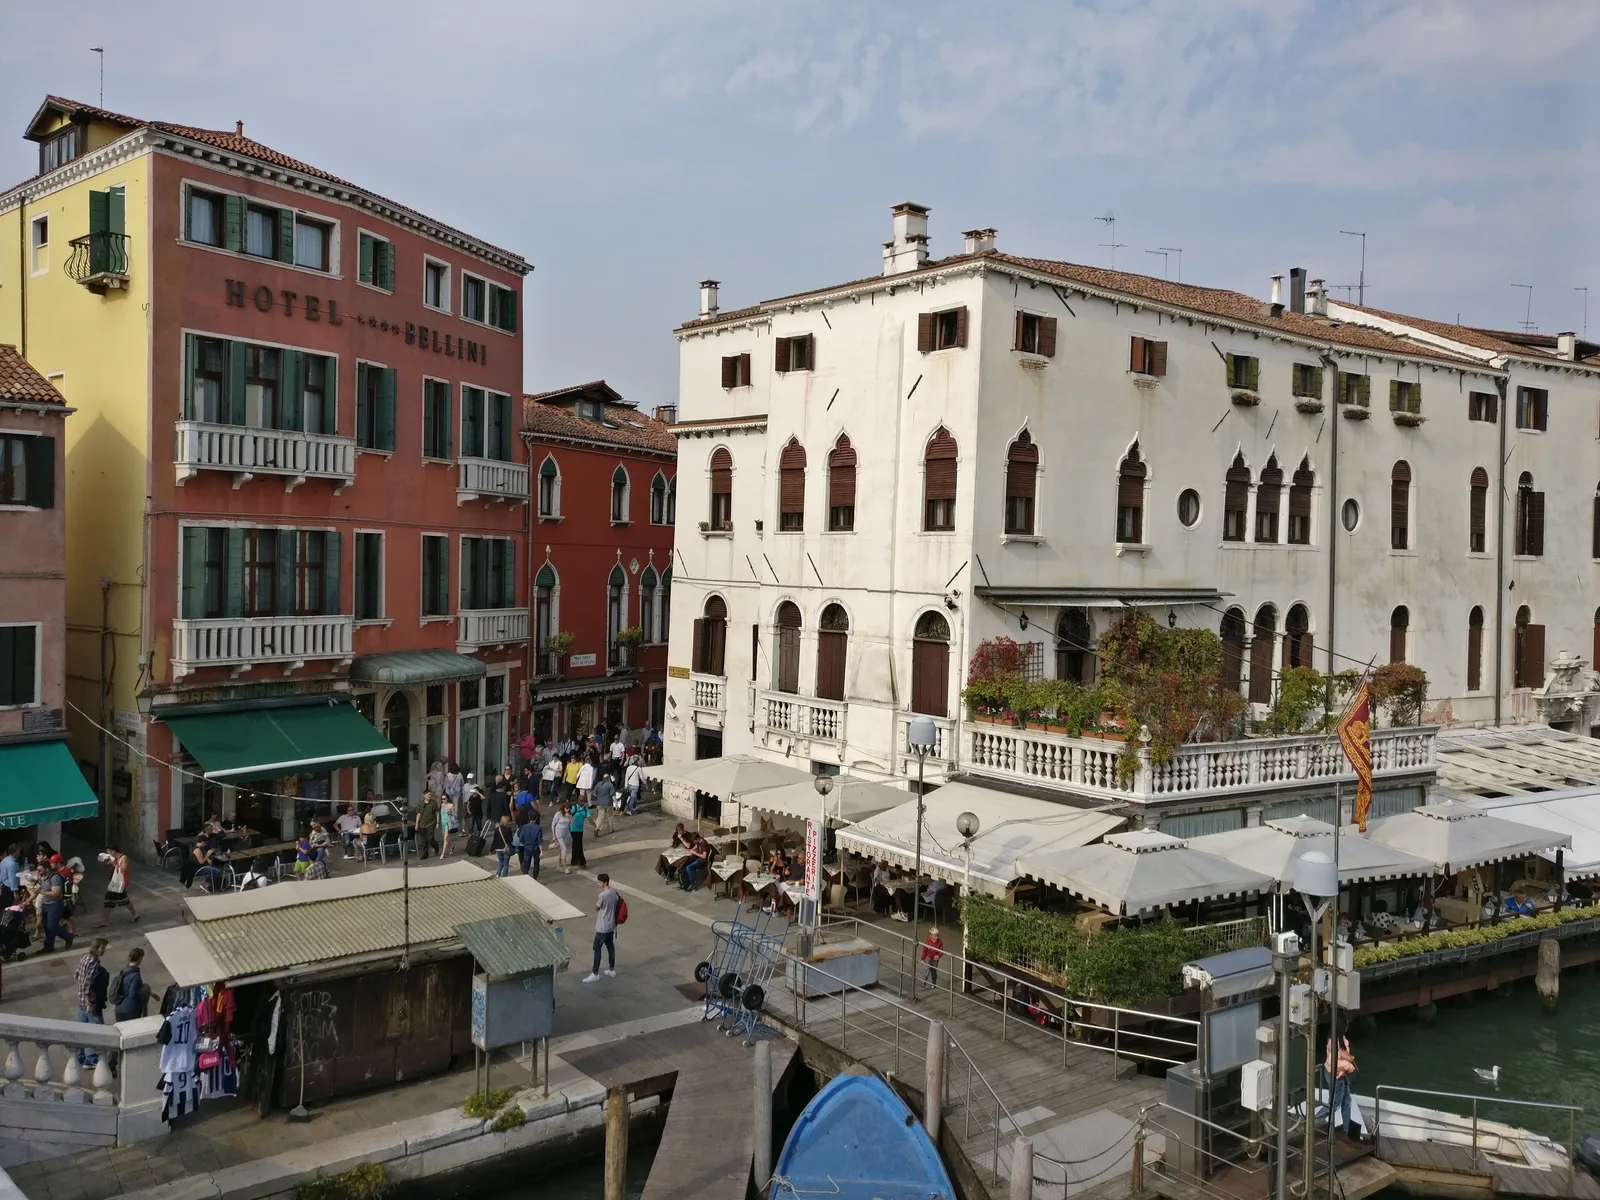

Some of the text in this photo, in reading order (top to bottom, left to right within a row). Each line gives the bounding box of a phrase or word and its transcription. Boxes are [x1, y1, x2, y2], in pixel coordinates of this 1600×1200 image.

[224, 278, 487, 366] HOTEL BELLINI
[428, 716, 443, 724] HOTEL
[840, 837, 954, 881] RISTORANTE ROMA
[174, 1021, 190, 1045] 10
